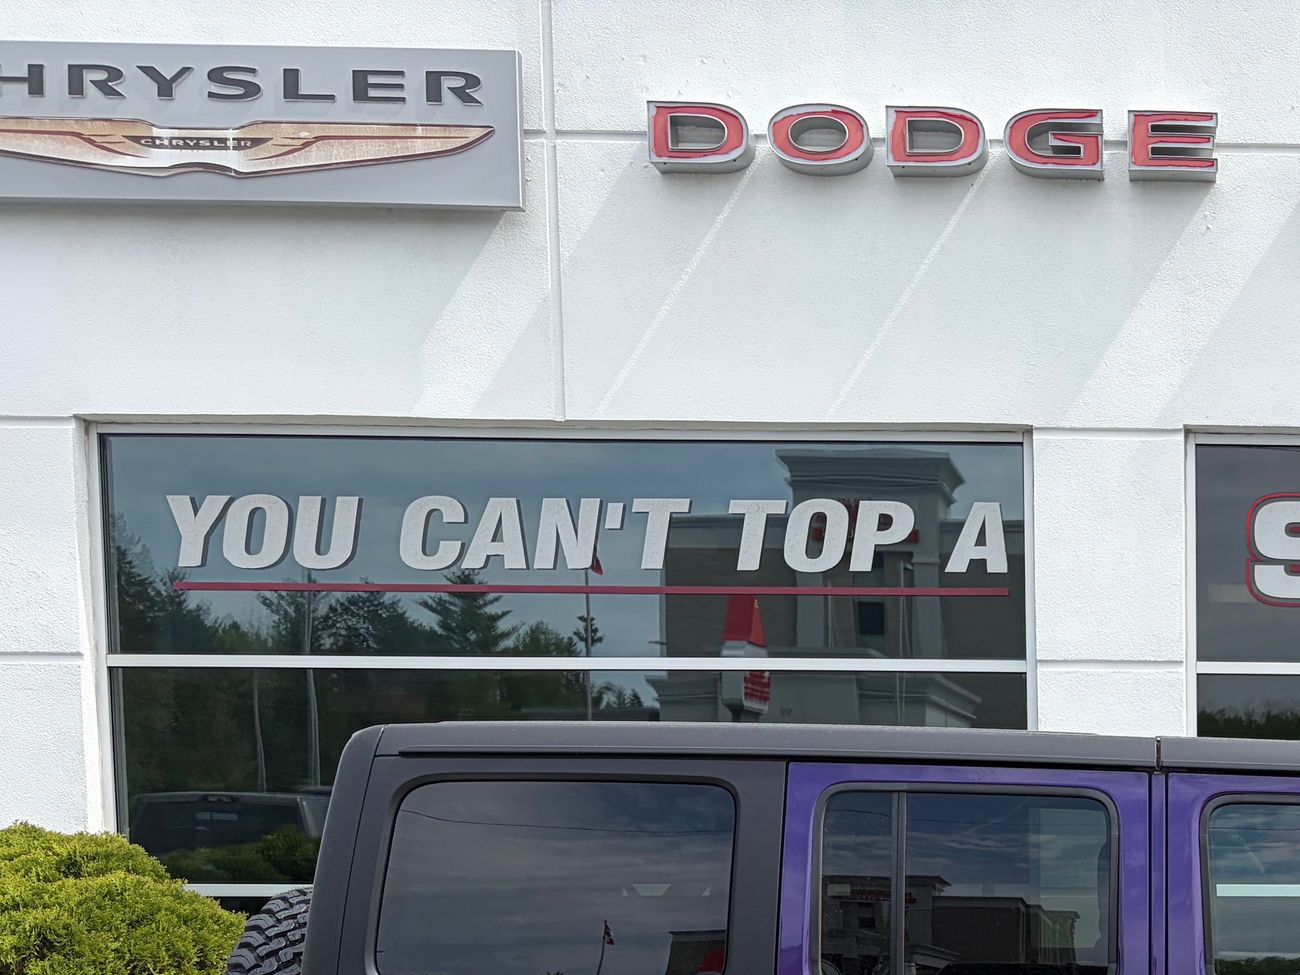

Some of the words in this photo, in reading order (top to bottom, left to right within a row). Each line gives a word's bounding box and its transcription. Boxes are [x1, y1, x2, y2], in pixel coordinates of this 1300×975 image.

[139, 136, 253, 148] CHRYSLER
[647, 100, 1219, 181] DODGE
[166, 493, 362, 570] YOU
[399, 495, 691, 570] CAN'T
[729, 498, 915, 574] TOP
[945, 501, 1009, 574] A
